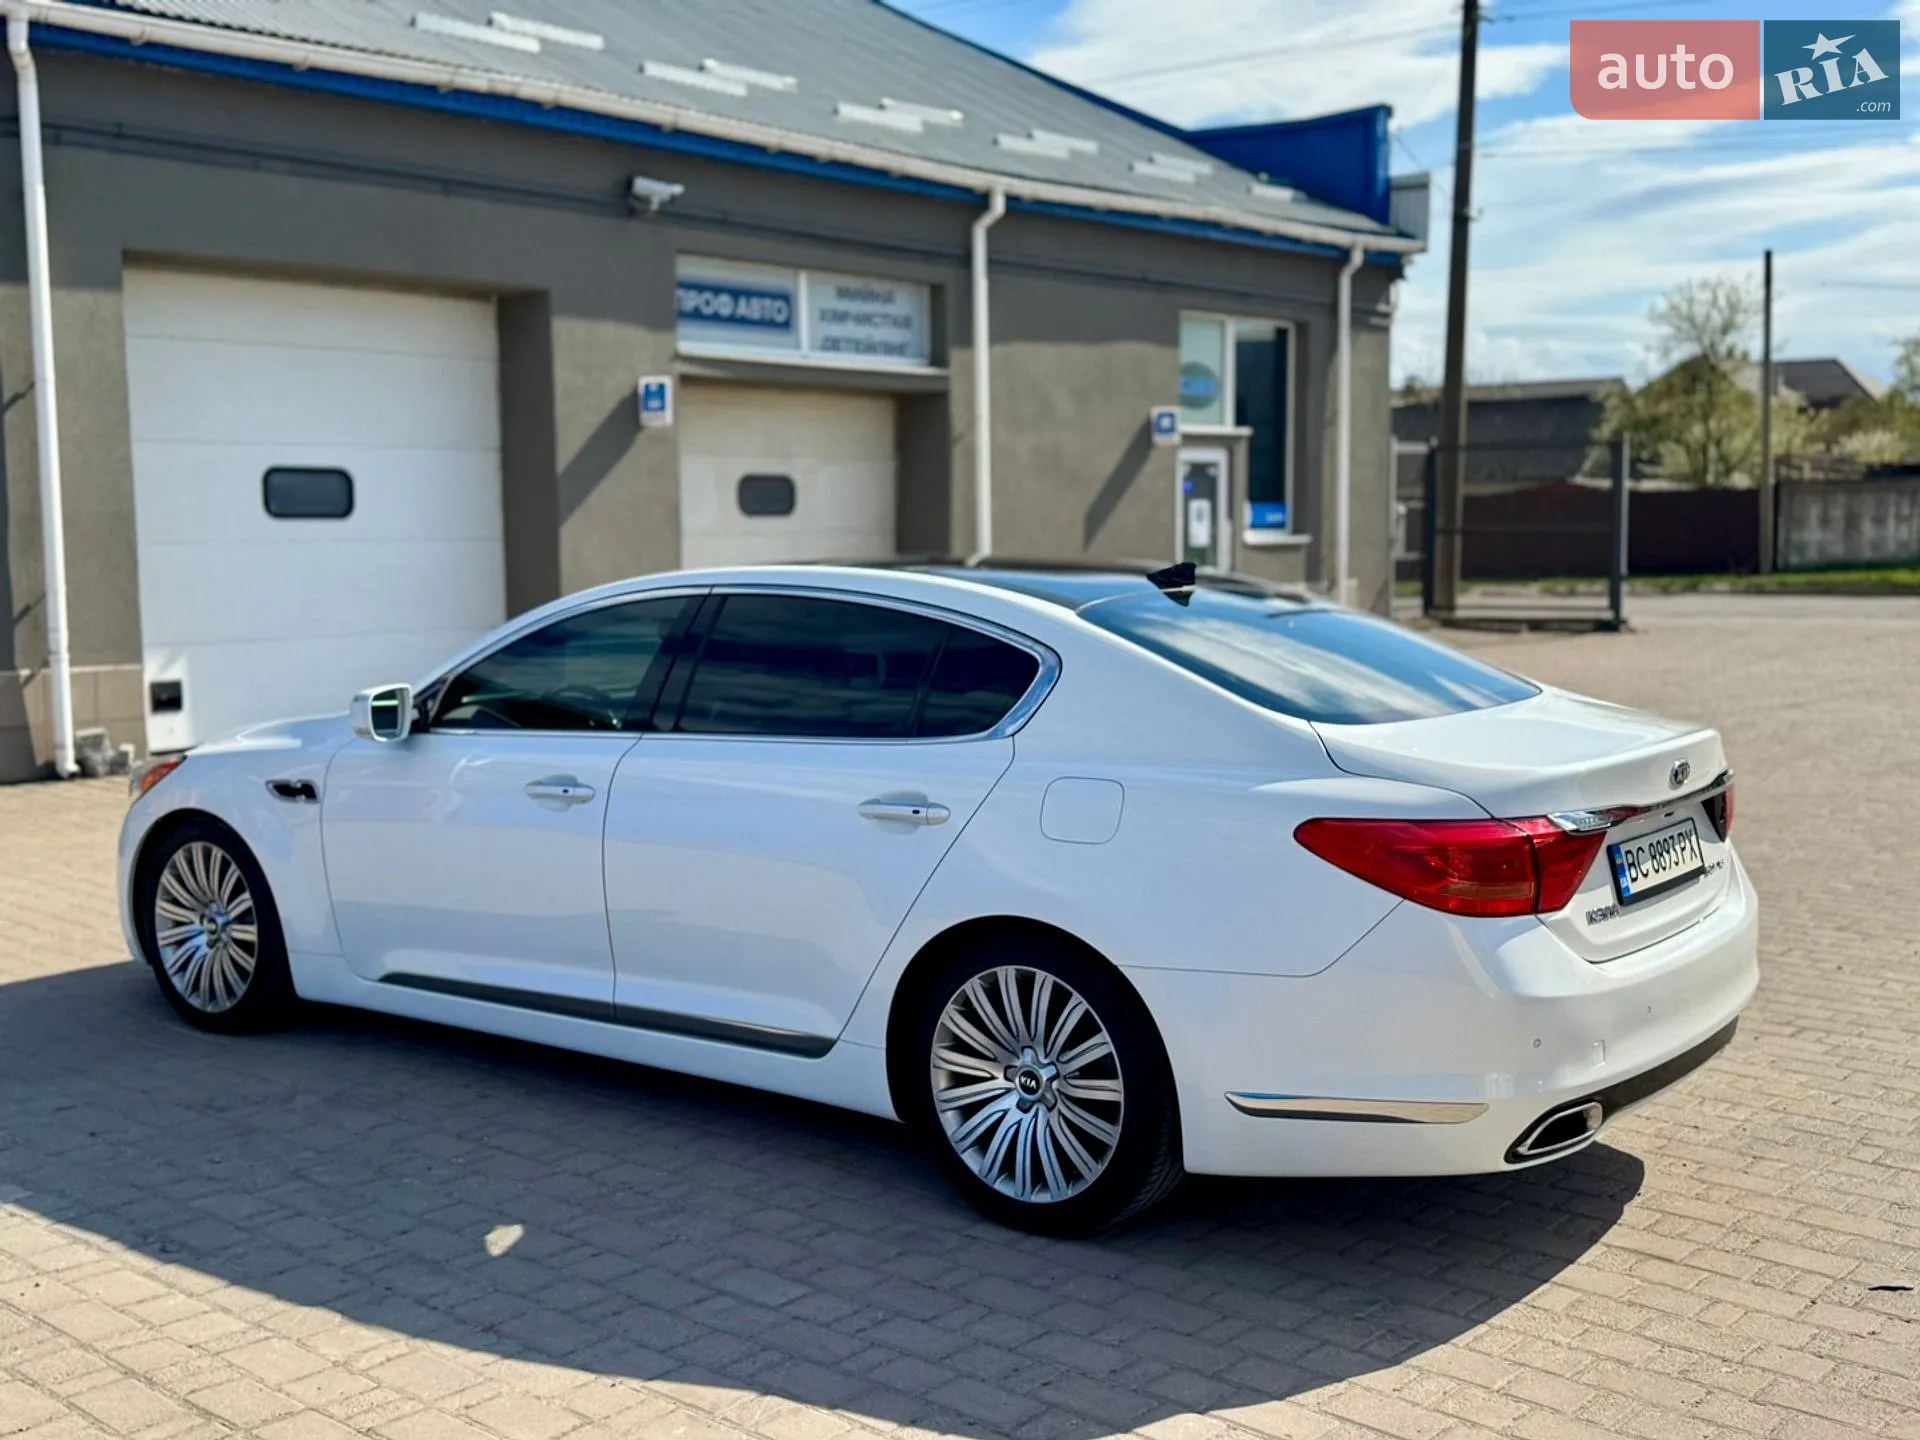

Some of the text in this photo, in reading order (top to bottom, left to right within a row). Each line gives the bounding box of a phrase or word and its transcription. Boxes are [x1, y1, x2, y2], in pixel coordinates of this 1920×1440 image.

[1624, 846, 1649, 882] BC
[1649, 834, 1680, 874] 8893
[1679, 827, 1698, 864] PX
[1020, 1075, 1037, 1089] KIA
